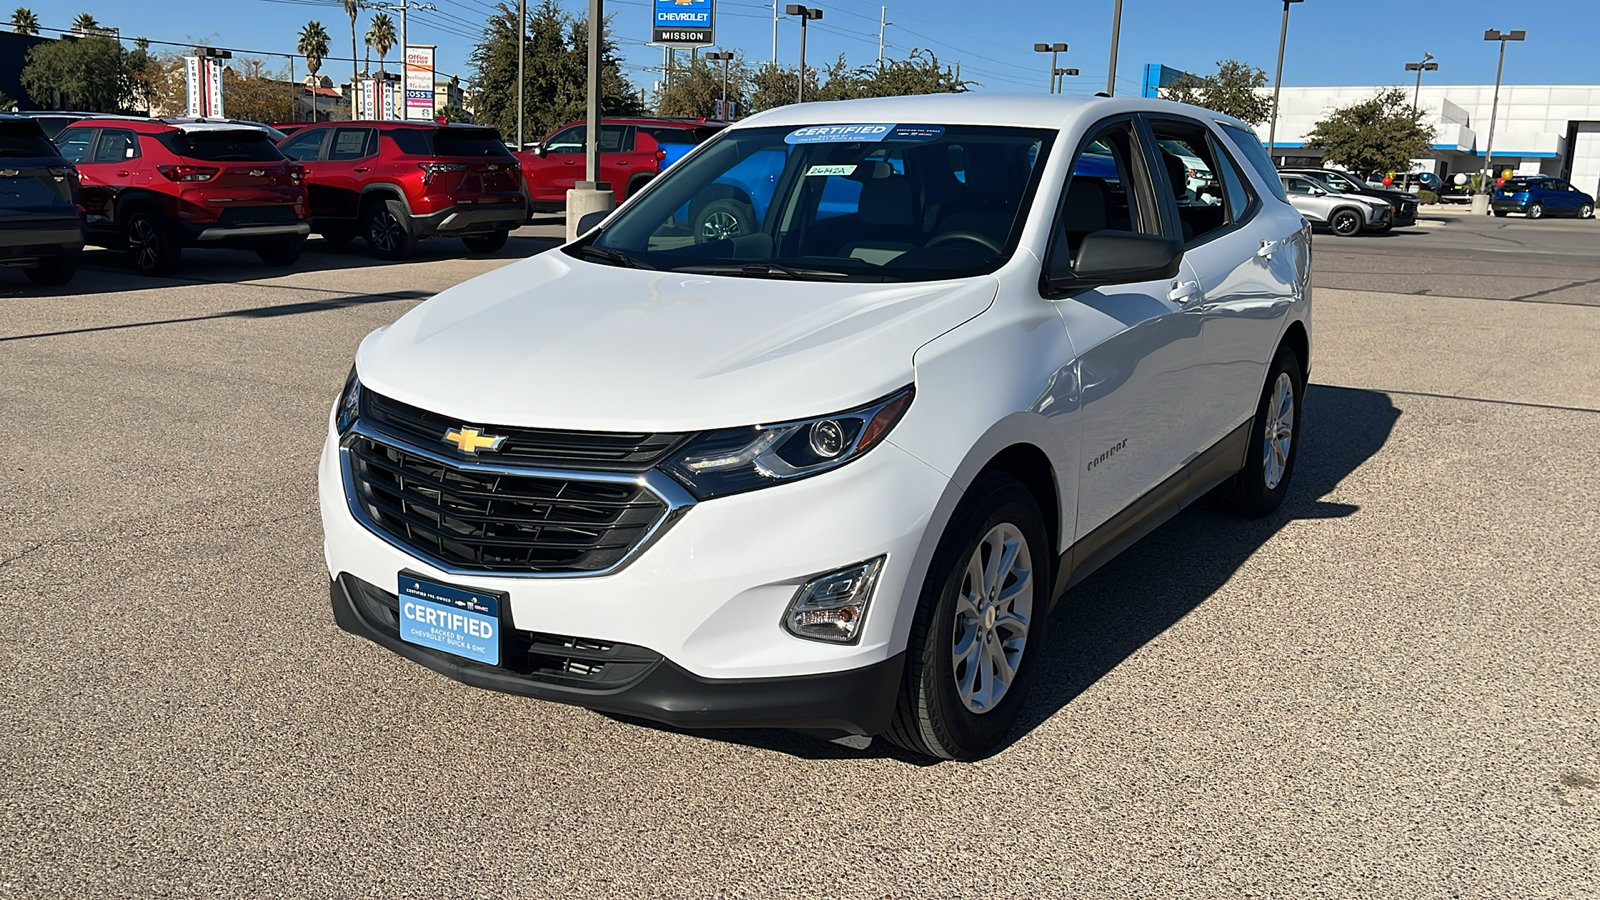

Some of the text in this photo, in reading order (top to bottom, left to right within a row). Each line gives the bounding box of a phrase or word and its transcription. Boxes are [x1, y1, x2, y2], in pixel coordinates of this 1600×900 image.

[658, 12, 708, 21] CHEVROLET
[662, 32, 704, 40] MISSION
[794, 126, 887, 136] CERTIFIED
[404, 602, 493, 639] CERTIFIED
[430, 627, 465, 641] BACKED BY
[410, 628, 446, 642] CHEVROLET
[446, 637, 466, 648] BUICK
[472, 644, 486, 654] GMC
